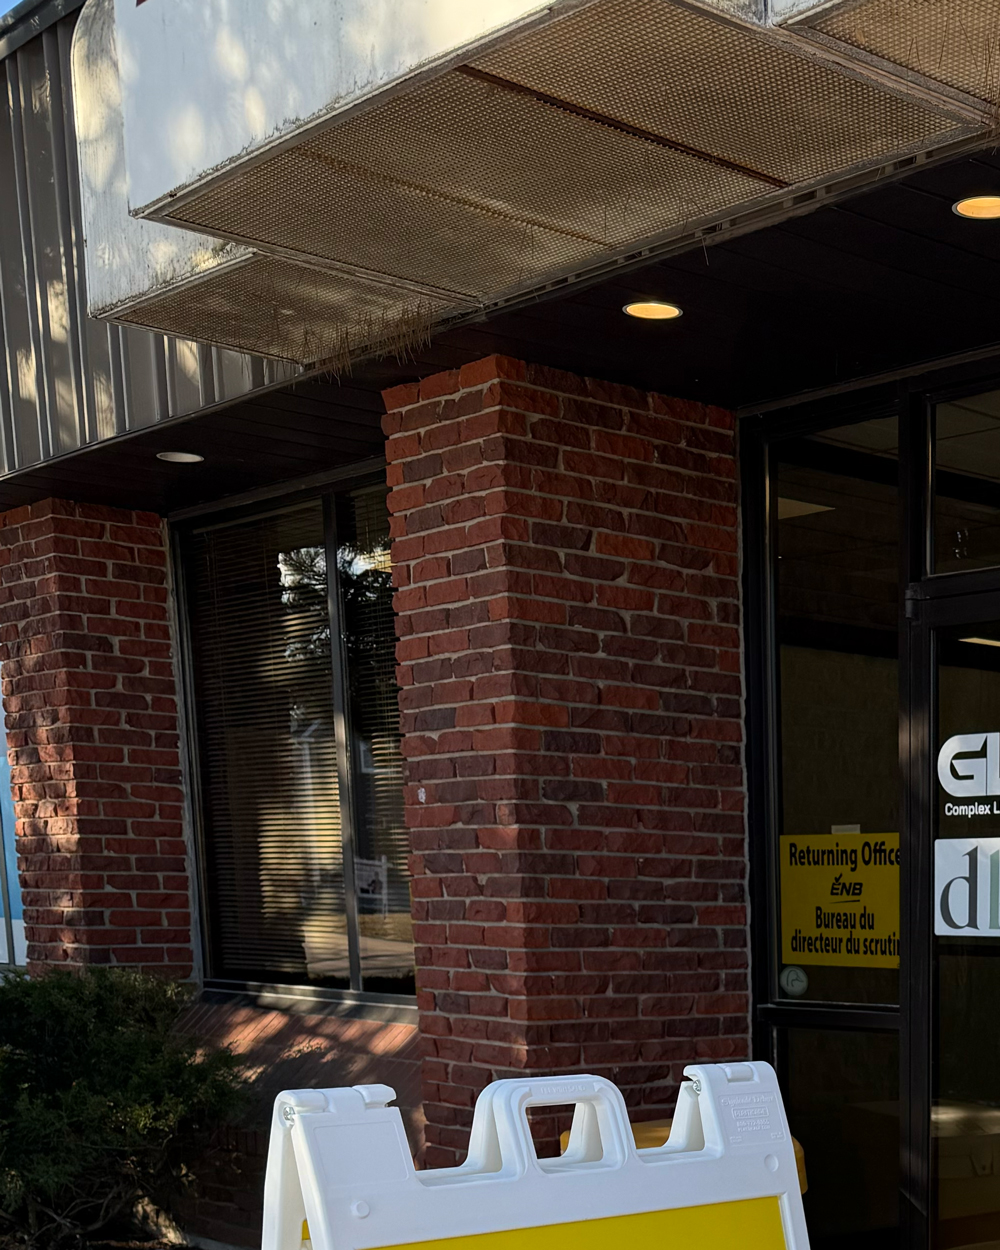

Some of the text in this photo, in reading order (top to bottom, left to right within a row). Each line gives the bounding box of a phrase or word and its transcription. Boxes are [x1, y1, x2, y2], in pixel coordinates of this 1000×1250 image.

[944, 802, 990, 818] Complex
[789, 841, 900, 872] Returning Office
[816, 906, 874, 930] Bureau du
[790, 929, 844, 954] directeur
[846, 930, 860, 954] du
